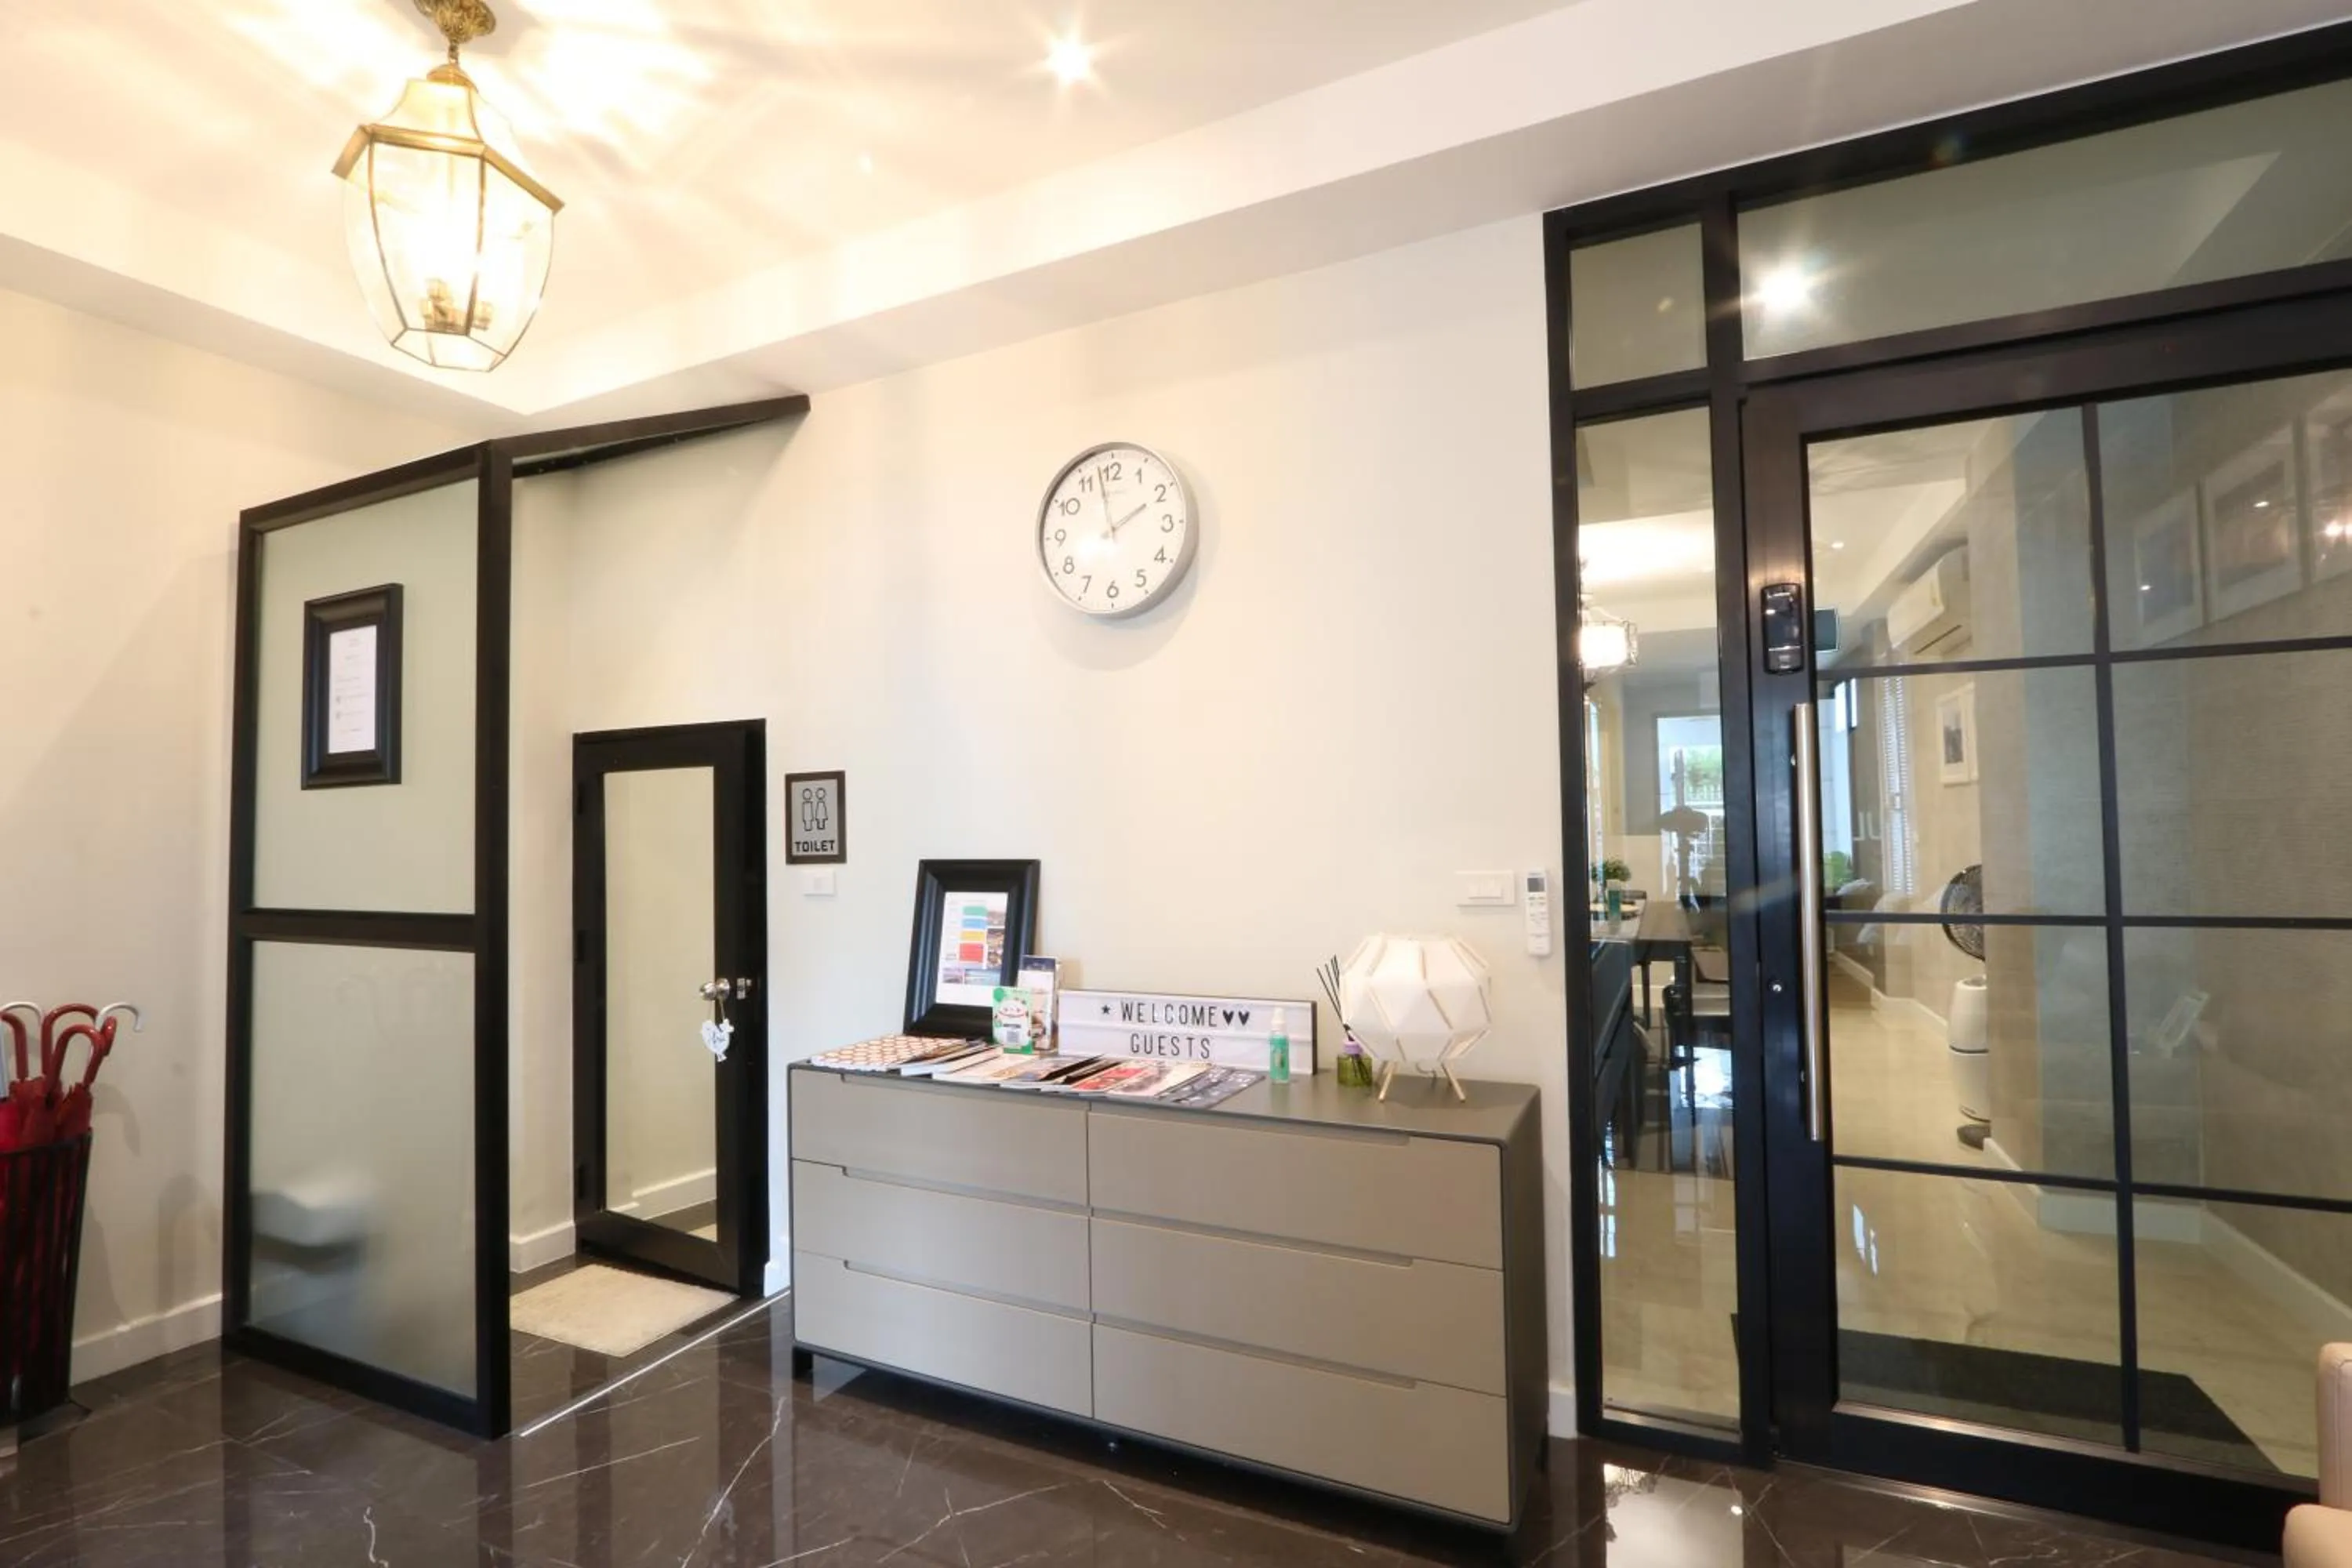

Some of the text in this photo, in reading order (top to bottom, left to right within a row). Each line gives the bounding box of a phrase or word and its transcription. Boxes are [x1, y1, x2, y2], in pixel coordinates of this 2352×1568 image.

[1103, 462, 1122, 481] 12
[1135, 468, 1142, 484] 1
[1079, 476, 1093, 492] 11
[1154, 484, 1167, 503] 2
[1058, 497, 1080, 516] 10
[1160, 514, 1174, 532] 3
[1054, 528, 1066, 547] 9
[1154, 546, 1167, 563] 4
[1063, 556, 1075, 574] 8
[1081, 575, 1091, 593] 7
[1134, 568, 1146, 587] 5
[1106, 580, 1119, 598] 6
[794, 840, 835, 852] TOILET
[1120, 1001, 1218, 1027] WELCOME
[1131, 1033, 1210, 1059] GUESTS
